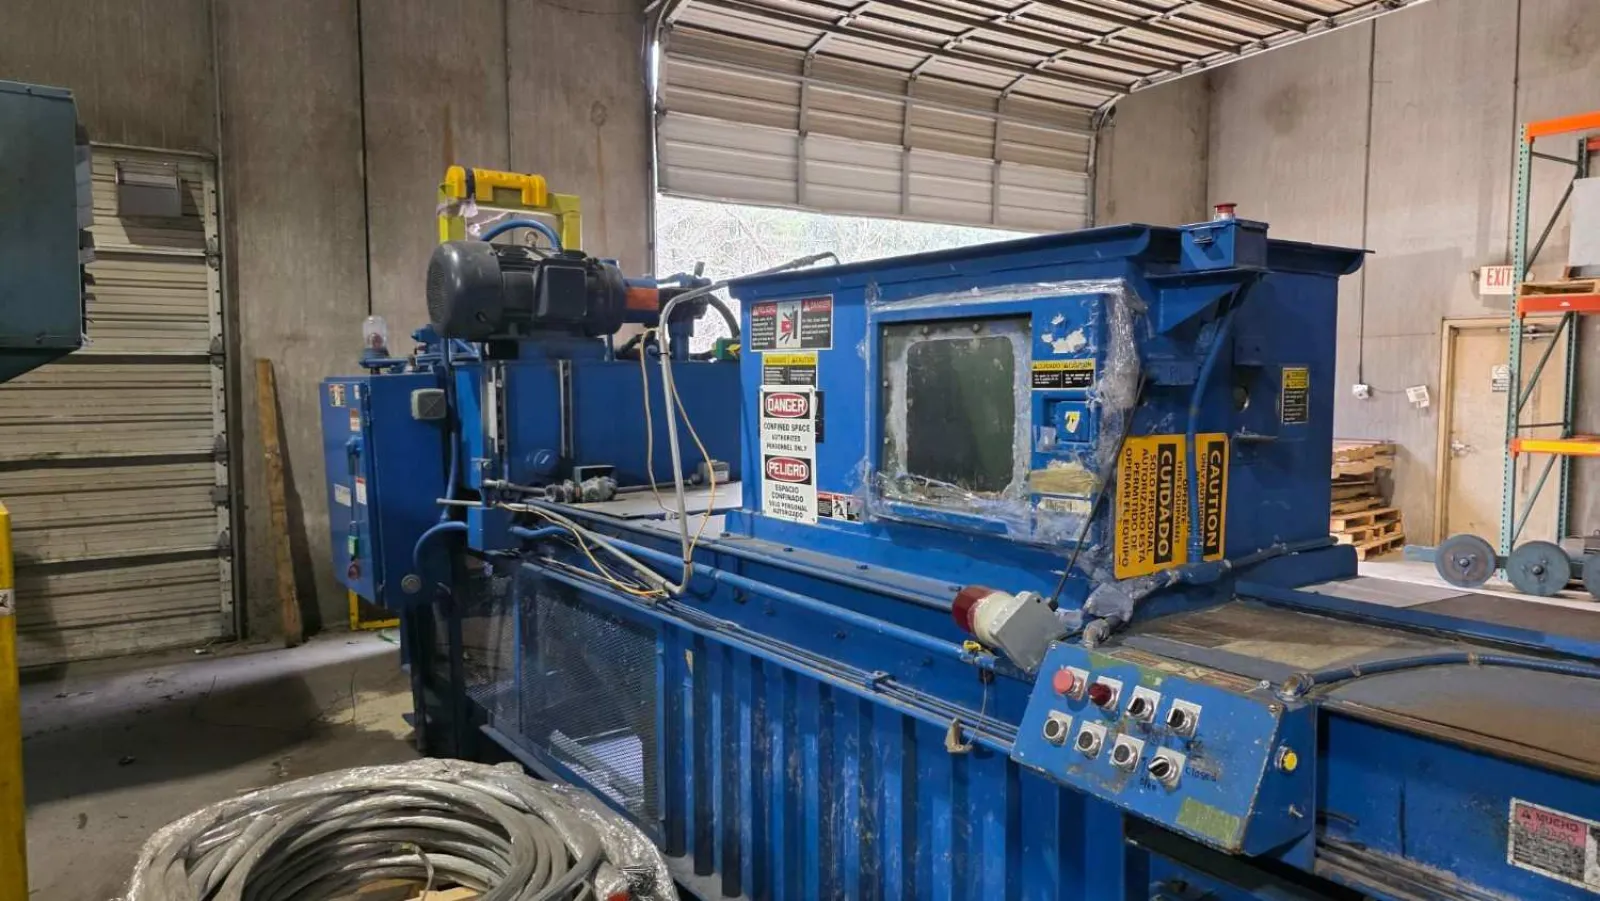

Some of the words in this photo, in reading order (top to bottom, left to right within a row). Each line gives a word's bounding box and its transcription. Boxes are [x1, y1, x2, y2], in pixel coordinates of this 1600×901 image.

[1487, 268, 1511, 286] EXIT
[767, 397, 806, 413] DANGER
[764, 421, 790, 432] CONFINED
[791, 423, 811, 432] SPACE
[766, 443, 793, 451] PERSONNEL
[794, 444, 808, 452] ONLY
[769, 461, 806, 477] PELIGRO
[1124, 447, 1132, 499] OPERAR
[1148, 454, 1157, 488] SOLO
[771, 491, 804, 503] CONFINADO
[775, 484, 800, 494] ESPACIO
[1131, 463, 1139, 531] PERMITIDO
[1139, 448, 1149, 531] AUTORIZADO
[1206, 450, 1221, 547] CAUTION
[1123, 502, 1130, 514] EL
[1158, 450, 1173, 557] CUIDADO
[772, 508, 804, 519] AUTORIZADO
[1174, 484, 1182, 544] EQUIPMENT
[1146, 490, 1156, 557] PERSONAL
[1121, 517, 1130, 568] EQUIPO
[1130, 534, 1138, 551] DE
[1536, 812, 1579, 832] MUCHO
